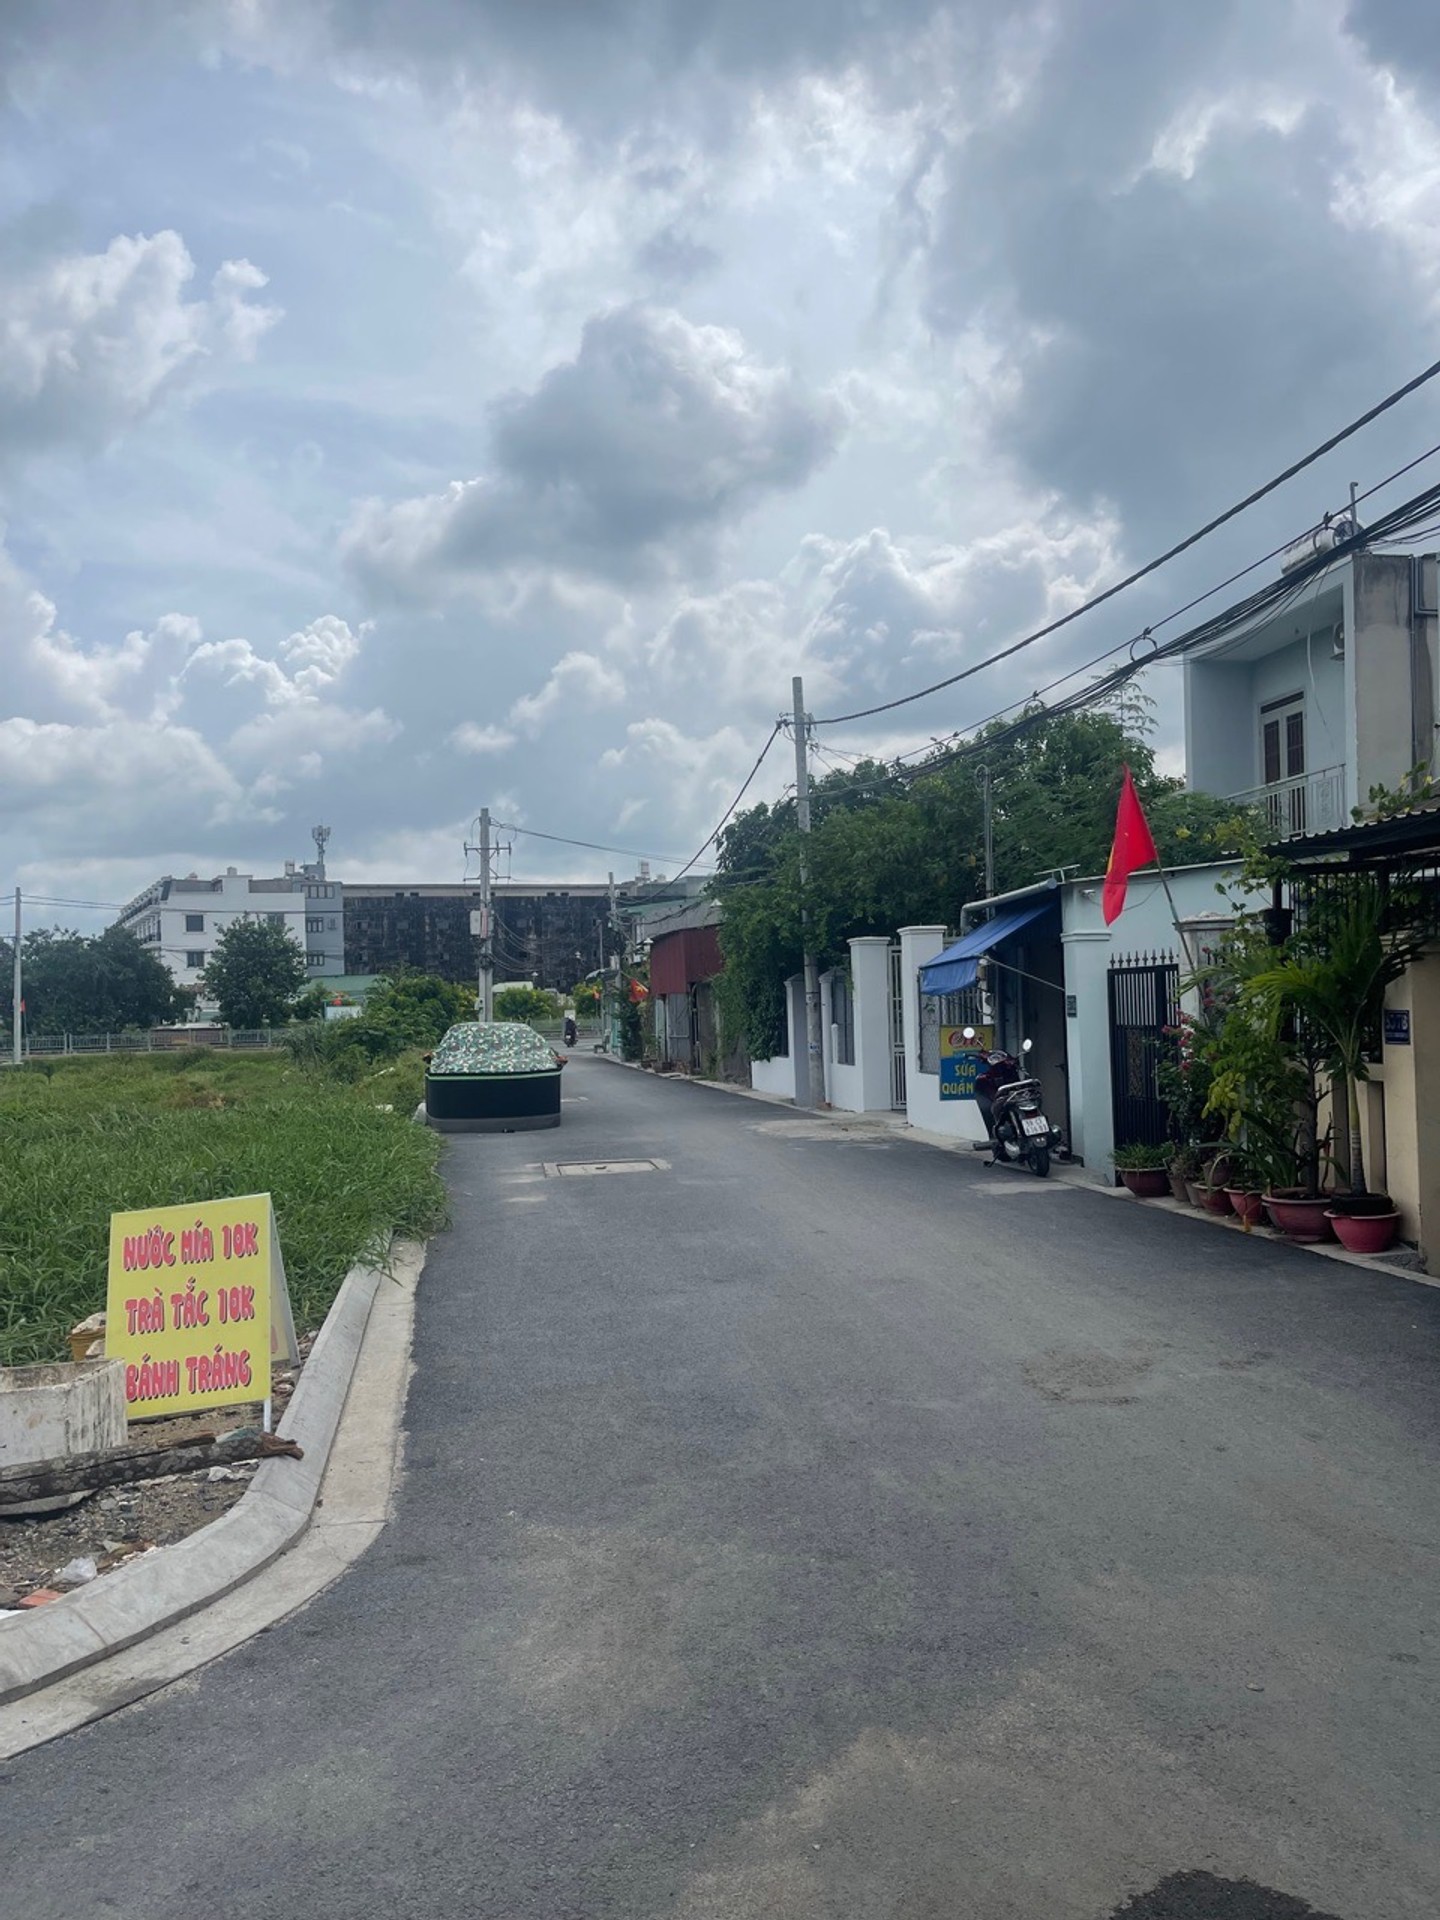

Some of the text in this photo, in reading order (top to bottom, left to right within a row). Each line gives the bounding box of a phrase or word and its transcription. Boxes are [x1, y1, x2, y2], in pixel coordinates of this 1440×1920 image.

[123, 1219, 259, 1272] NƯỚC MÍA 10K
[125, 1276, 255, 1335] TRÀ TẮC 10K
[125, 1344, 251, 1403] BÁNH TRÁNG
